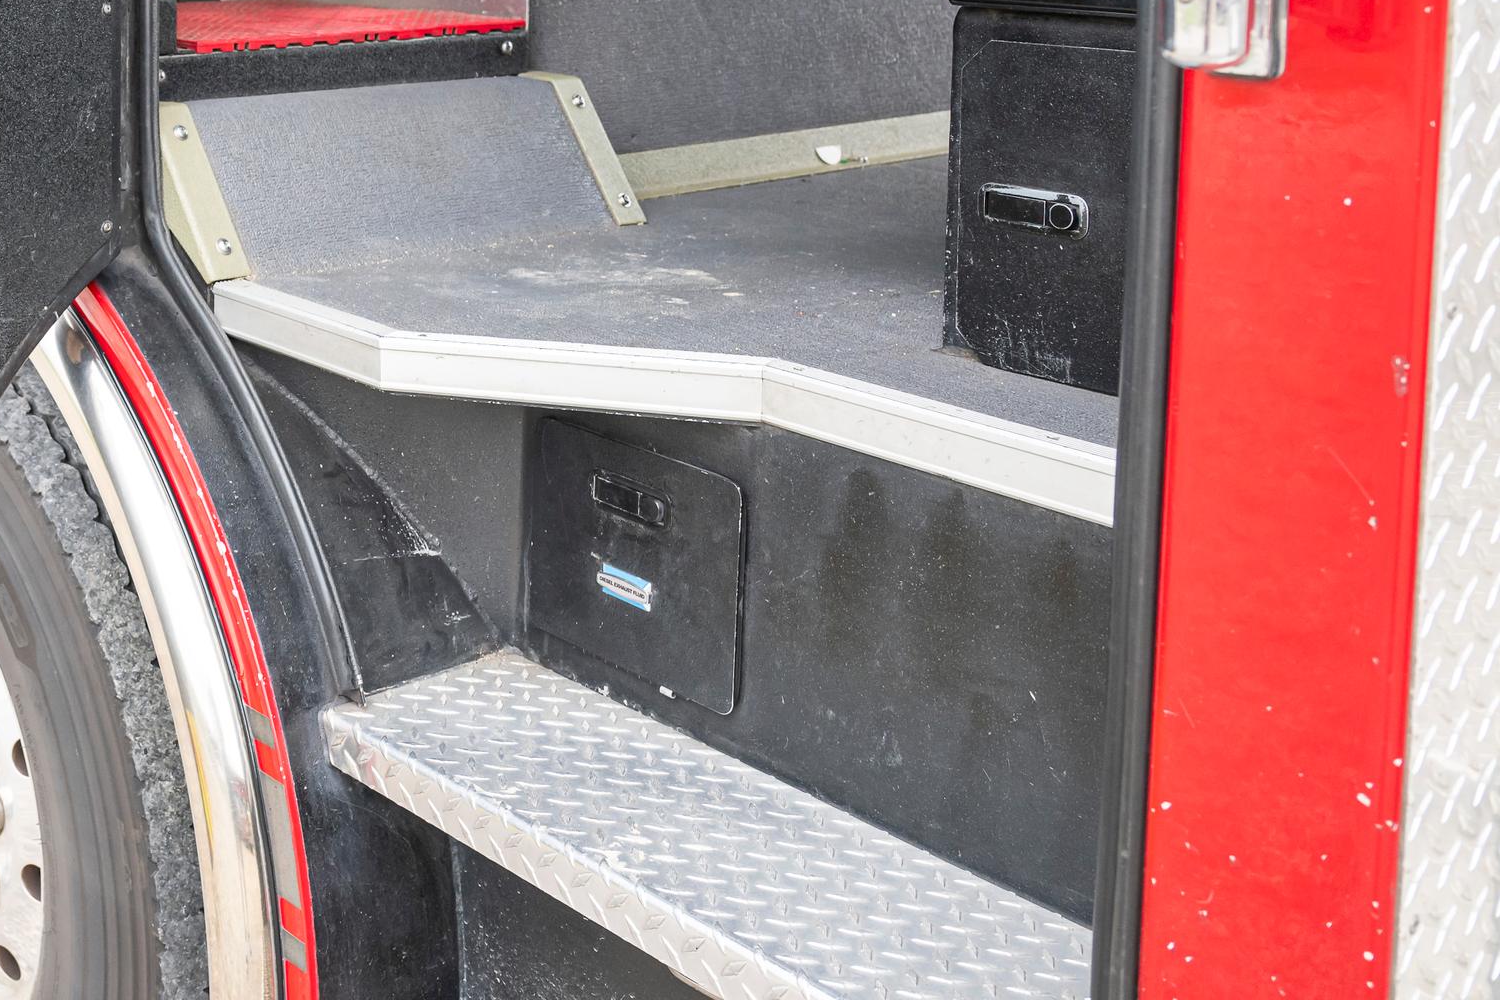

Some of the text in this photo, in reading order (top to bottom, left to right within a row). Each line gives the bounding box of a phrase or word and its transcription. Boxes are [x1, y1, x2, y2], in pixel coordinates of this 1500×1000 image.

[599, 576, 645, 599] DIESEL EXHAUST FLUID
